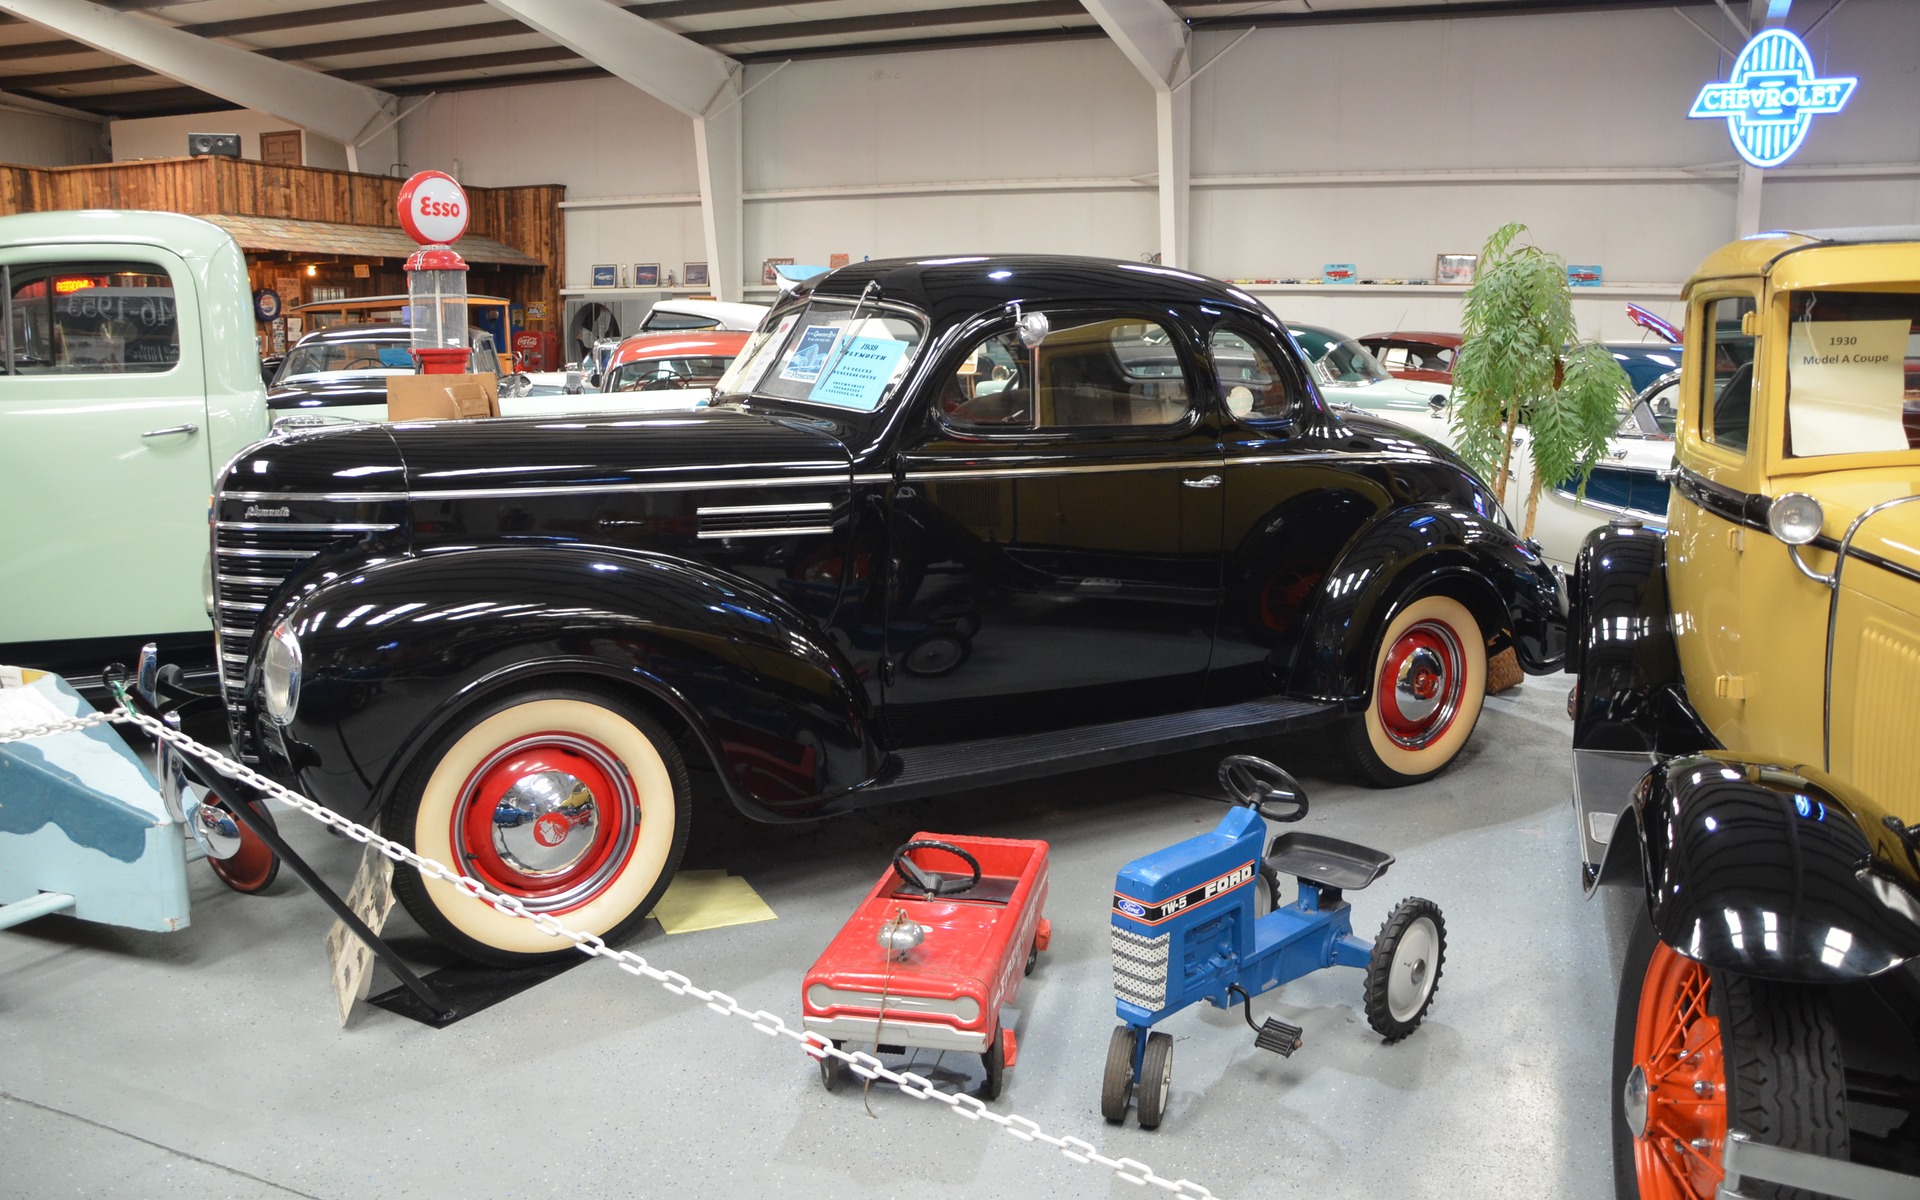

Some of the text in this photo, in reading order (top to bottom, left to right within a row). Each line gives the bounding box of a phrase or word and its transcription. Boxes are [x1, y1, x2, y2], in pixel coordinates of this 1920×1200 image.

[1704, 85, 1841, 110] CHEVROLET
[420, 196, 461, 219] Esso
[860, 343, 879, 351] 1939
[1829, 336, 1858, 347] 1930
[844, 350, 887, 361] PLYMOUTH
[1803, 354, 1889, 365] Model A Coupe
[1204, 864, 1253, 900] FORD
[1122, 902, 1141, 915] Ford
[1160, 895, 1188, 917] TW-5
